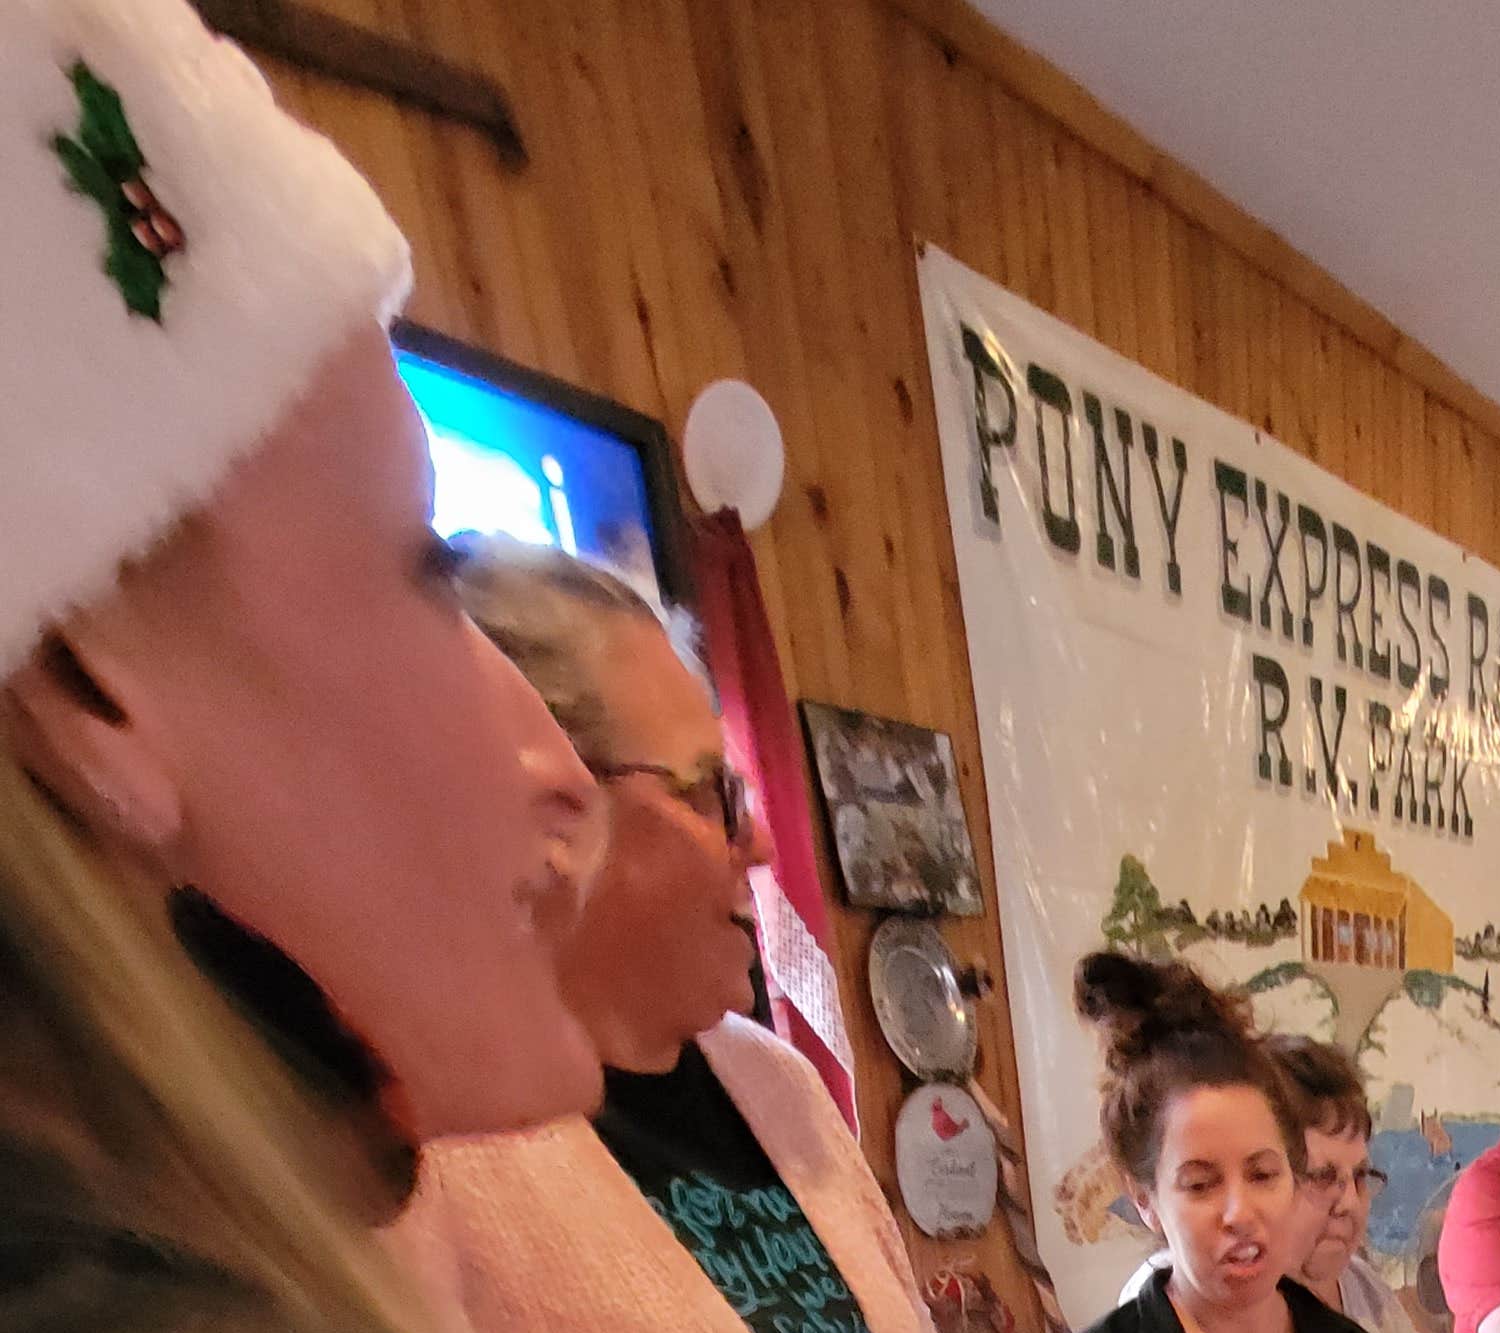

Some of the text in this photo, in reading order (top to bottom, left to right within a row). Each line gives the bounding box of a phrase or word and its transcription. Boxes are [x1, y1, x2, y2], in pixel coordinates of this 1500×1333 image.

[960, 319, 1188, 597] PONY
[1213, 458, 1451, 699] EXPRESS
[1368, 698, 1474, 837] PARK
